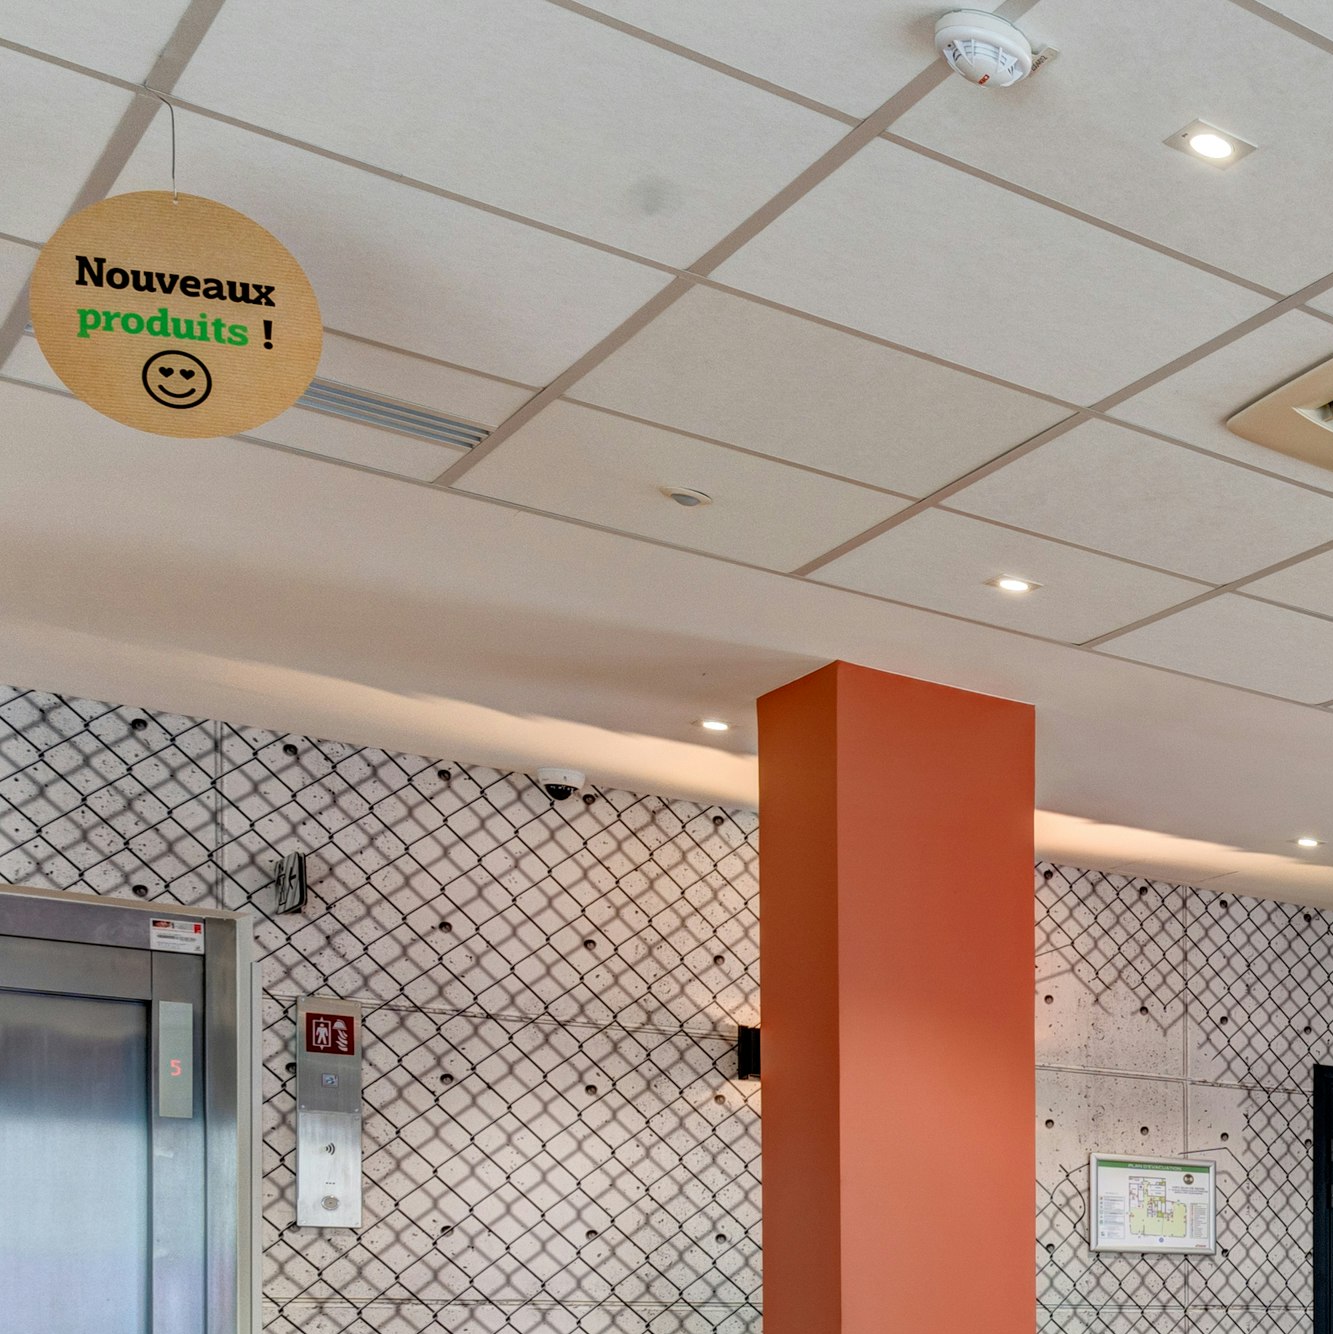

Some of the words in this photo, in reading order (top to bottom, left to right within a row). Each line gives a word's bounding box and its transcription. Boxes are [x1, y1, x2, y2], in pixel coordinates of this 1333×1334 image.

[75, 255, 276, 307] Nouveaux
[76, 307, 249, 347] produits
[262, 319, 274, 350] !
